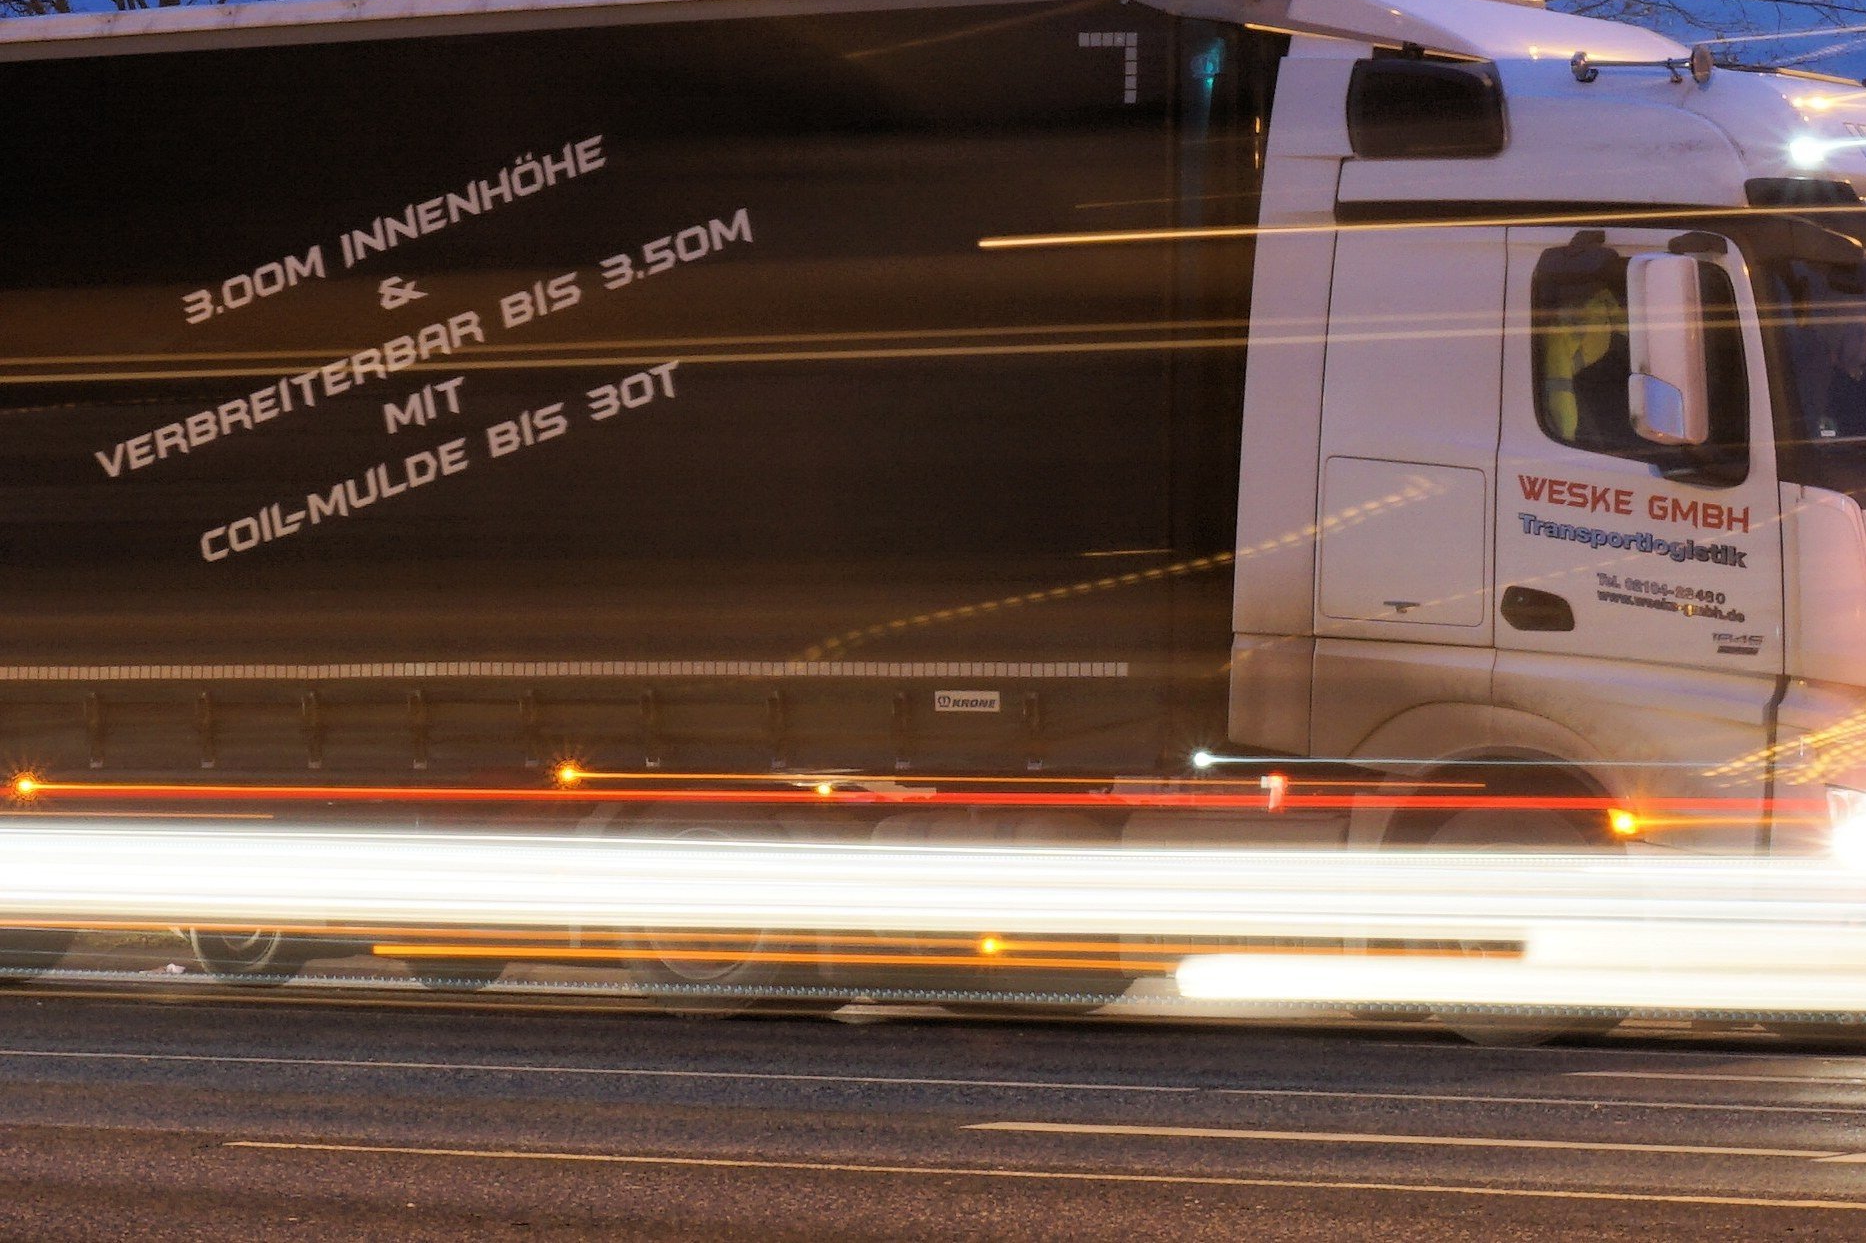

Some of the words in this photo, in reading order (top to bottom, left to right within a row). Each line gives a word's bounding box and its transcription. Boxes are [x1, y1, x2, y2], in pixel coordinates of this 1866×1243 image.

[340, 135, 606, 269] INNENHÖHE
[377, 276, 428, 311] &
[95, 311, 485, 478] VERBREITERBAR
[499, 271, 582, 329] BIS
[600, 208, 753, 291] 3.50M
[383, 376, 466, 435] MIT
[200, 437, 470, 562] COIL-MULDE
[486, 402, 568, 458] BIS
[587, 360, 681, 422] 30T
[1518, 474, 1634, 516] WESKE
[1648, 495, 1750, 534] GMBH
[1518, 512, 1748, 569] Transportlogistik
[952, 698, 996, 709] KRONE
